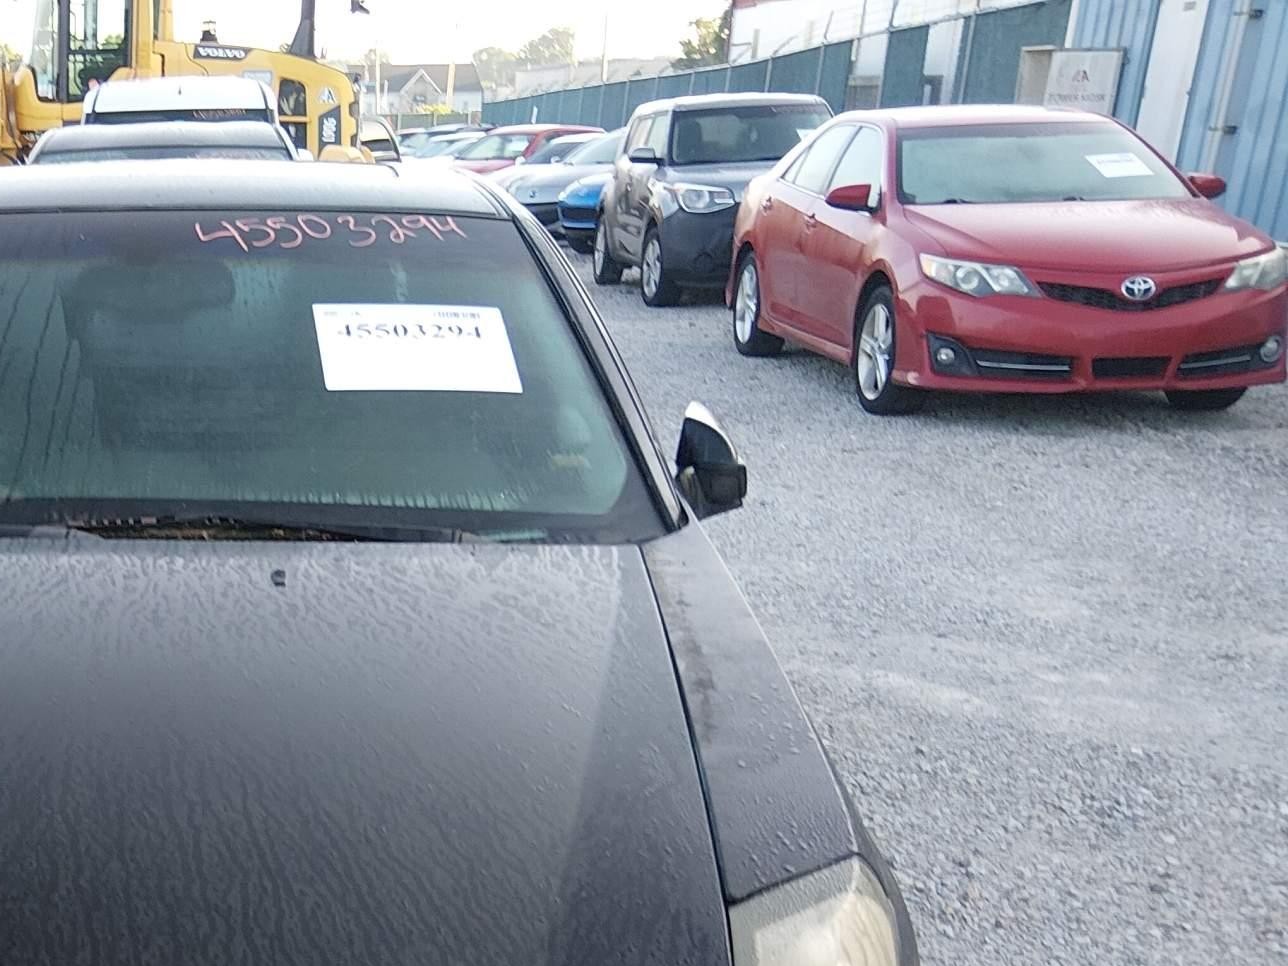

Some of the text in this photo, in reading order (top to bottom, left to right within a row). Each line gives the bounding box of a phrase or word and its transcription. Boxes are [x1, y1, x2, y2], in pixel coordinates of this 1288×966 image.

[197, 46, 246, 59] VOLVO
[195, 215, 468, 252] 45503294
[338, 323, 482, 339] 45503294
